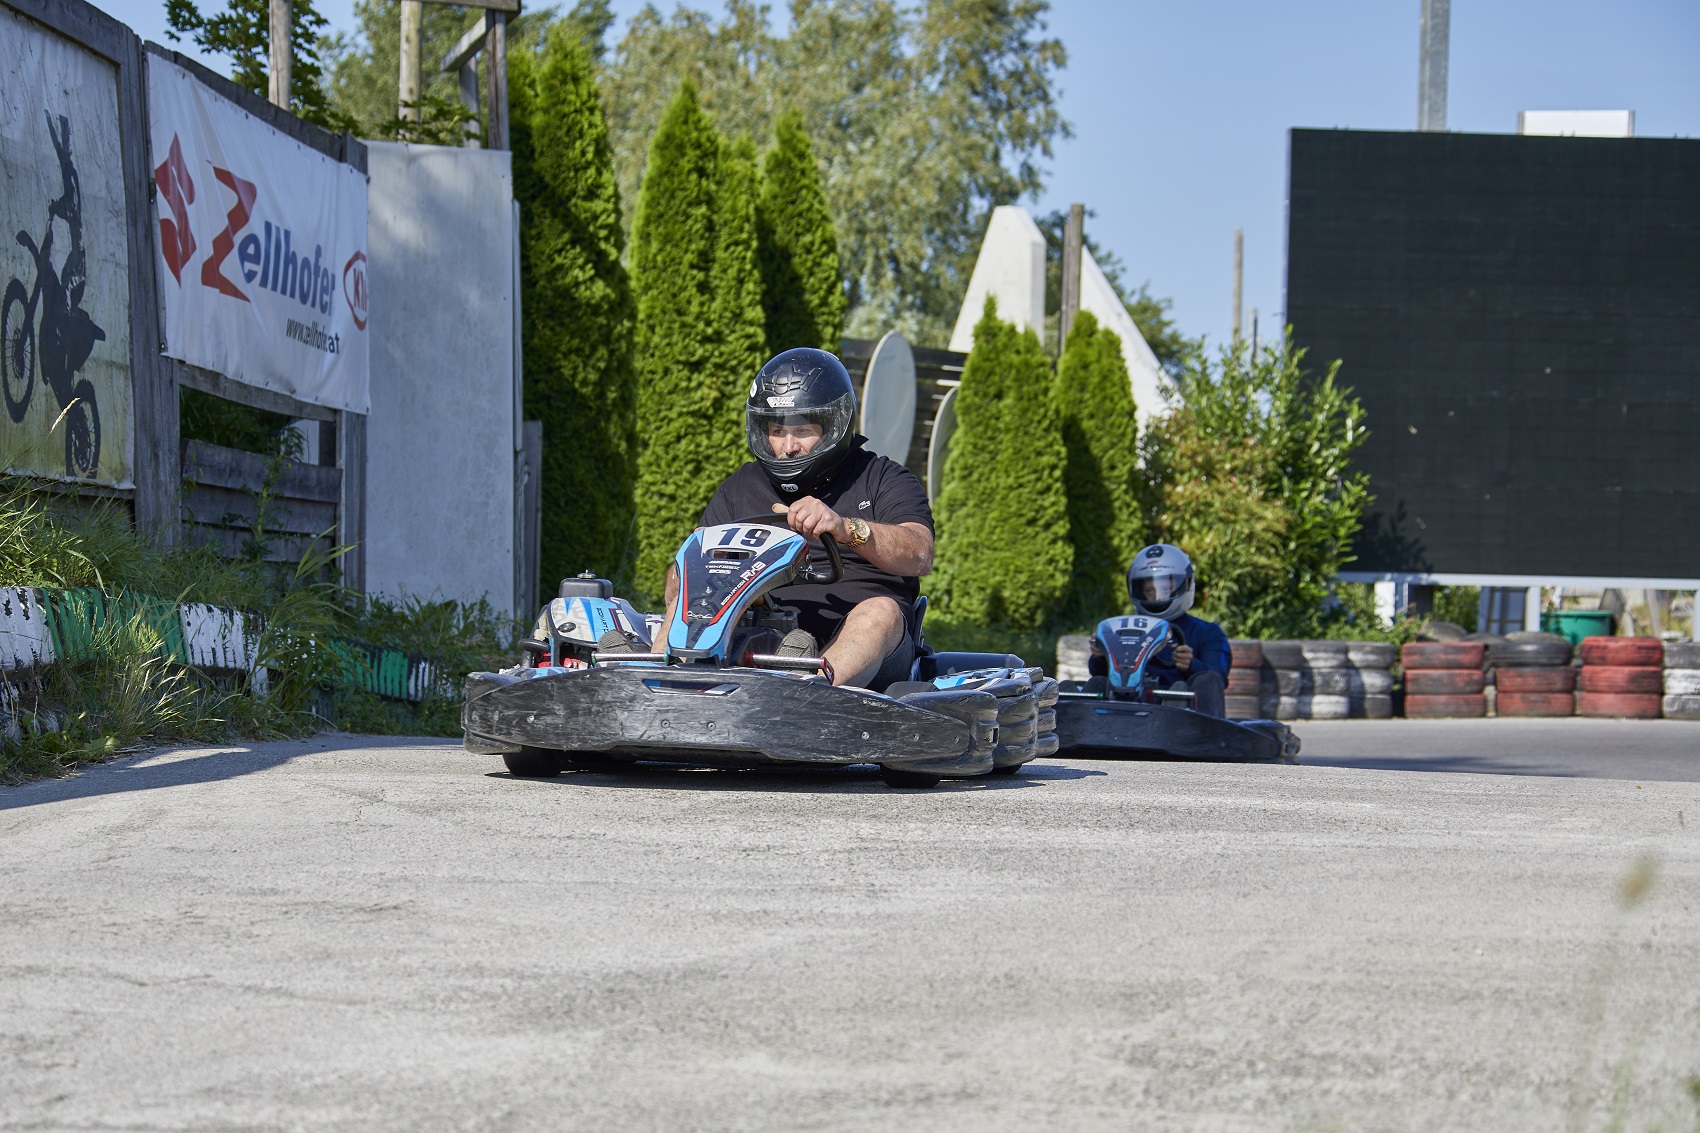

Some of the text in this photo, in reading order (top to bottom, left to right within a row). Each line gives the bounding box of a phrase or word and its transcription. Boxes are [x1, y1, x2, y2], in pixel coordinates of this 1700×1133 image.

[201, 160, 336, 316] Zellhofer
[717, 527, 772, 548] 19
[1117, 617, 1148, 629] 16
